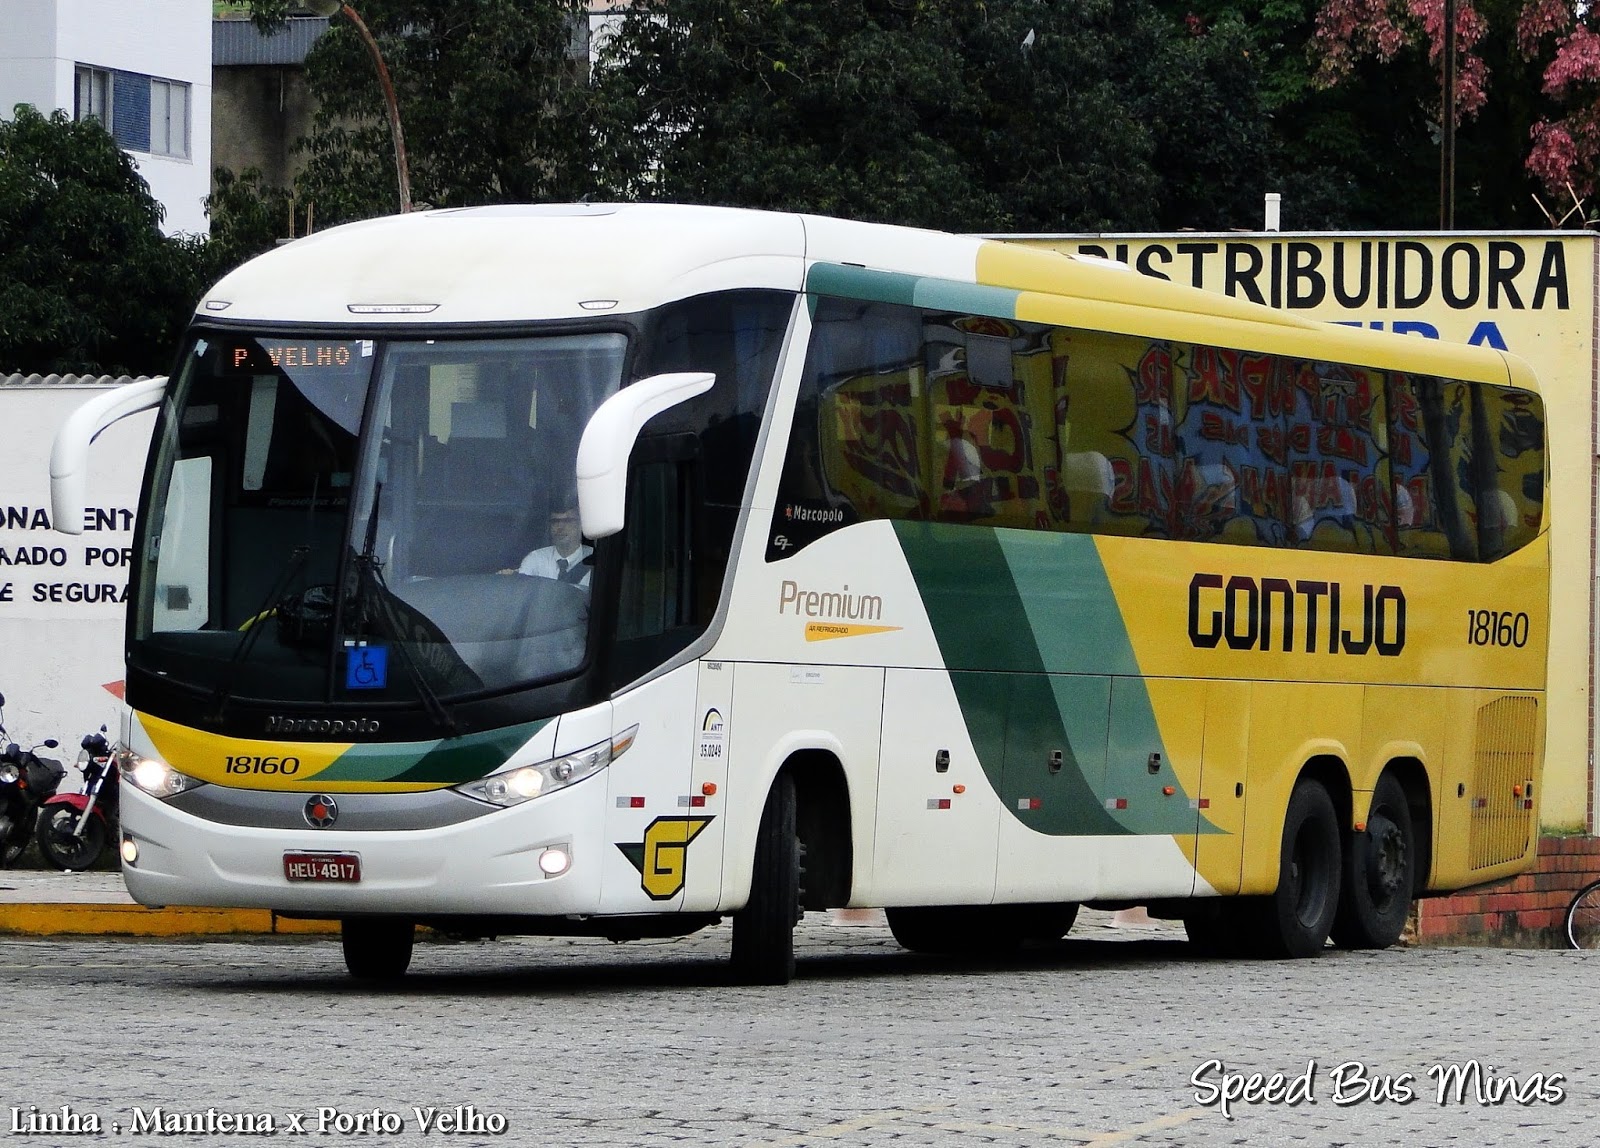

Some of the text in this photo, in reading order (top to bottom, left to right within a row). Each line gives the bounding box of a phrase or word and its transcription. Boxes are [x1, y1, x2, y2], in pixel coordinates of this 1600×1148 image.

[269, 346, 350, 366] VELHO
[793, 505, 844, 524] Marcopolo
[779, 579, 883, 621] Premium
[1187, 572, 1407, 657] GONTIJO
[1467, 608, 1530, 649] 18160
[265, 715, 380, 735] Marcopolo
[224, 755, 301, 776] 18160
